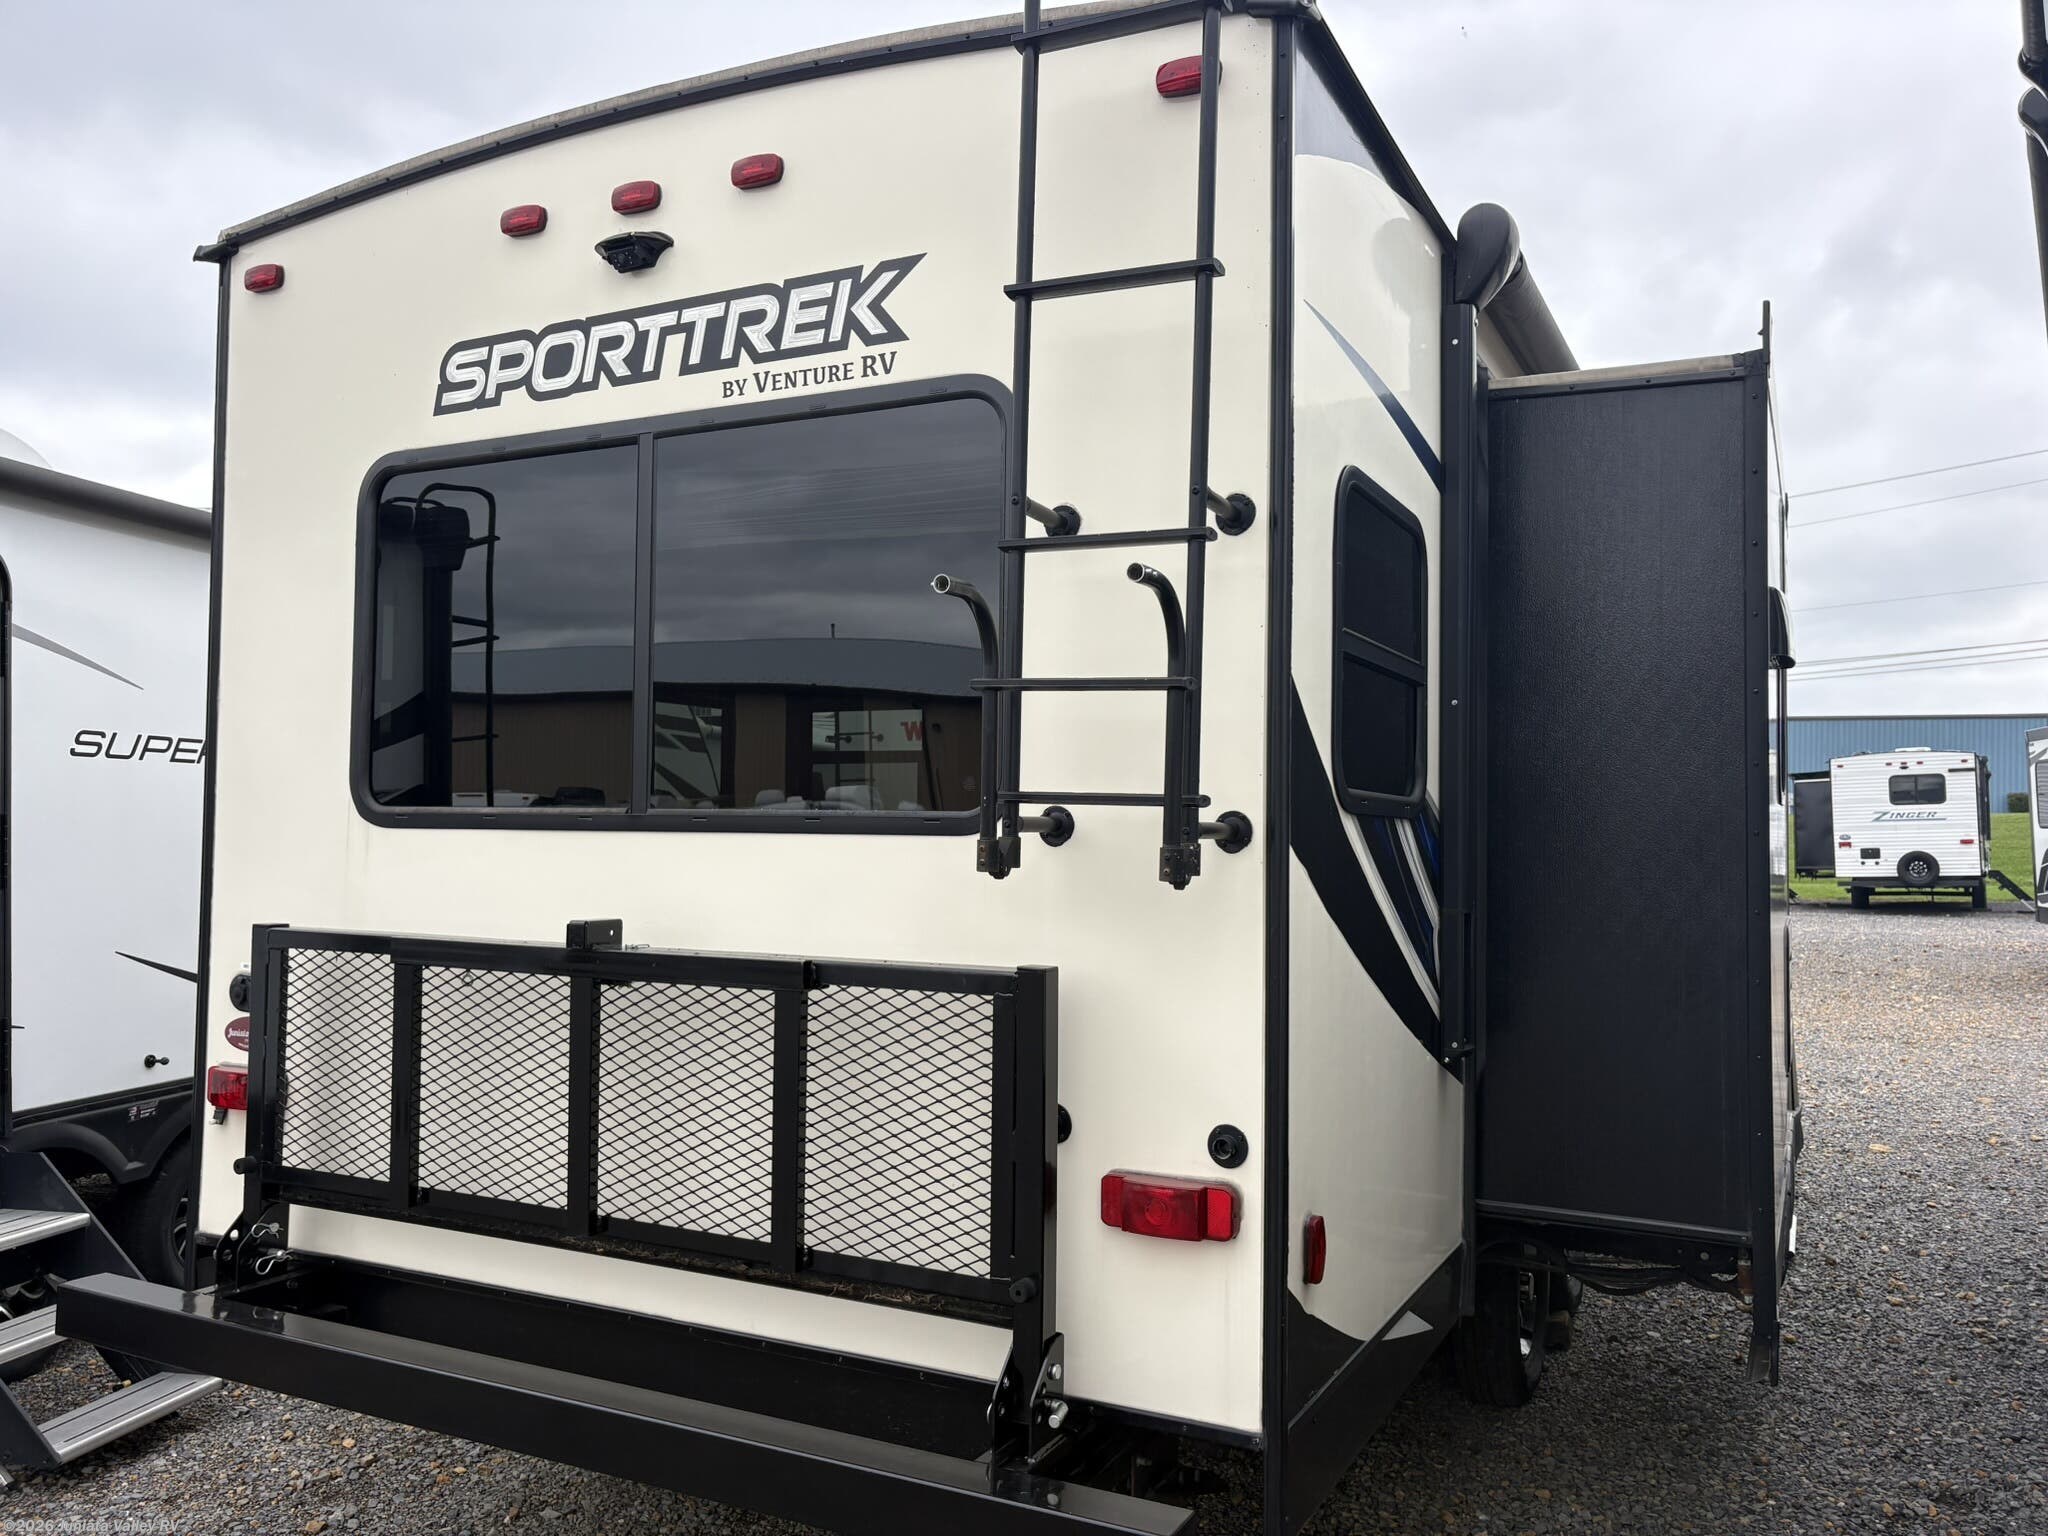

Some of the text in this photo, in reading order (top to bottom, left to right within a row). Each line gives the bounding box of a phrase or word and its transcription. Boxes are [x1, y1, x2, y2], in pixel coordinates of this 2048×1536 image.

[434, 254, 926, 416] SPORTTREK
[722, 351, 898, 398] BY VENTURE RV
[1872, 810, 1946, 822] ZINGER
